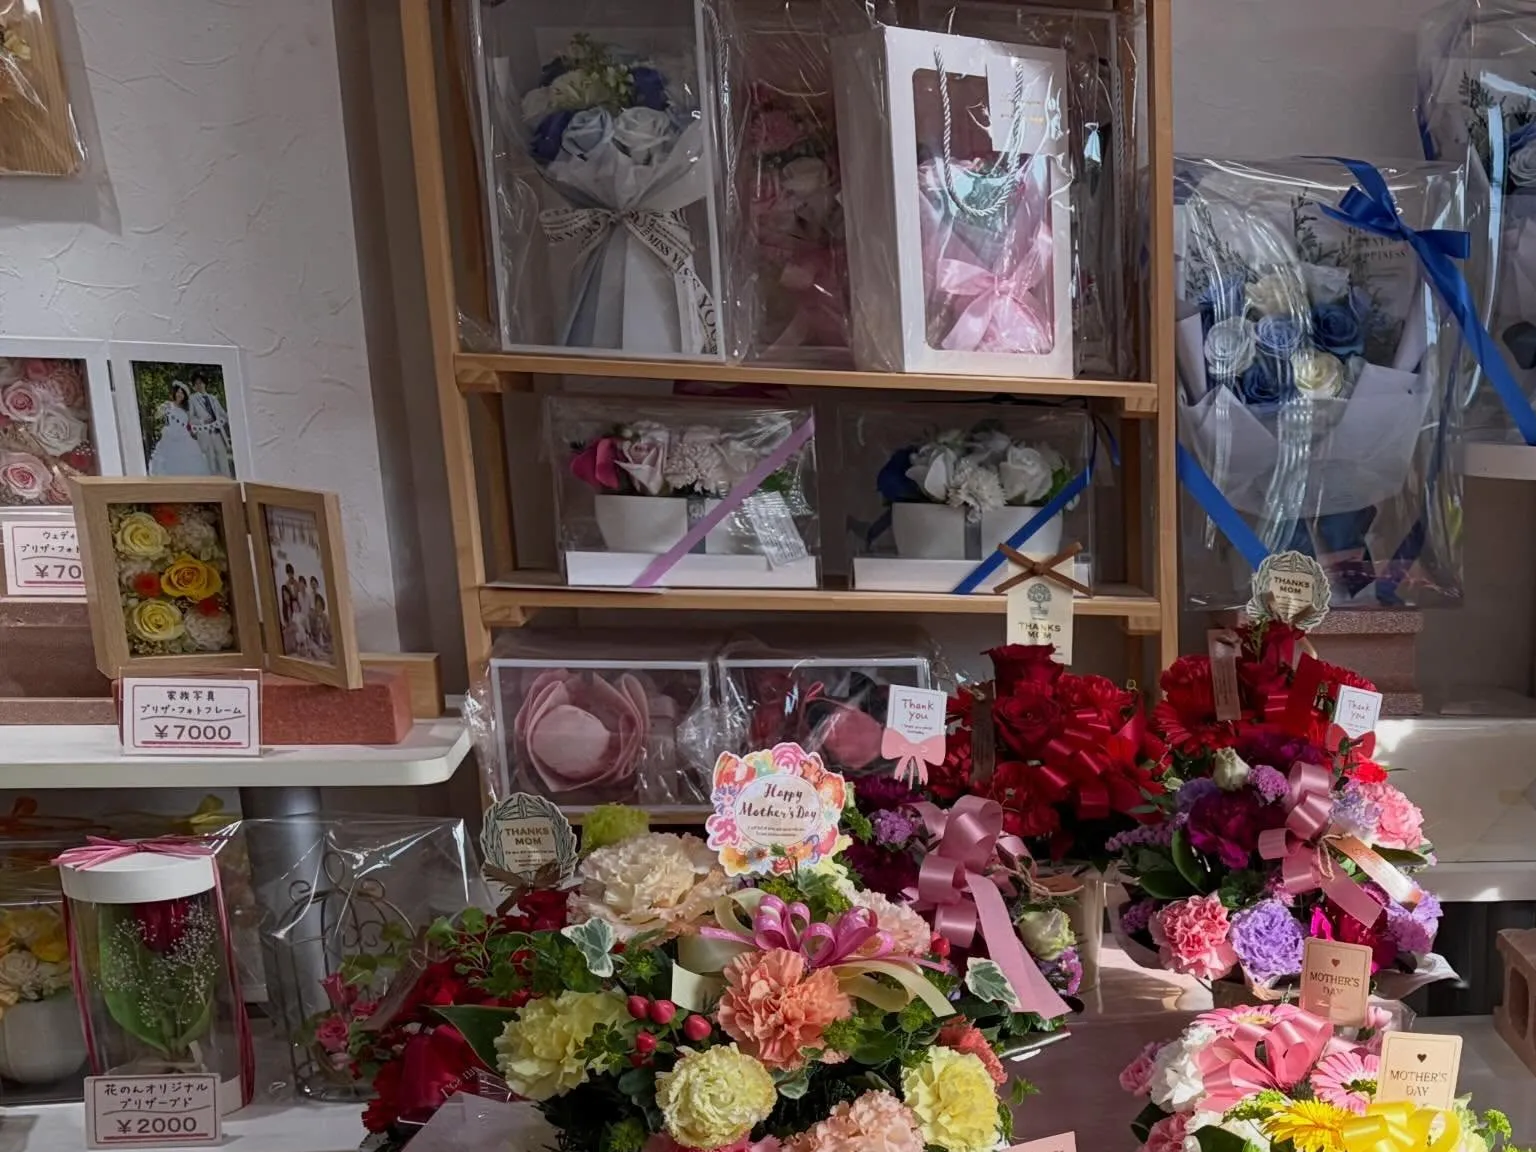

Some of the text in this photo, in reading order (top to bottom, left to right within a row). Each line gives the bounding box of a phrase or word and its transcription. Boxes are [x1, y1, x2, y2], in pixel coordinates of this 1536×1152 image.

[1274, 577, 1310, 588] THANKS
[167, 691, 215, 701] 家族写真
[901, 699, 933, 710] Thank
[154, 725, 231, 740] ¥7000
[764, 783, 802, 802] Happy
[739, 802, 817, 823] Mother's Day
[1310, 972, 1360, 987] MOTHER'S
[1322, 986, 1344, 997] DAY
[1390, 1070, 1447, 1083] MOTHER'S
[105, 1083, 208, 1095] 花のんオリジナル
[1406, 1085, 1429, 1097] DAY
[120, 1097, 192, 1109] プリザーブド
[117, 1117, 196, 1134] ¥2000
